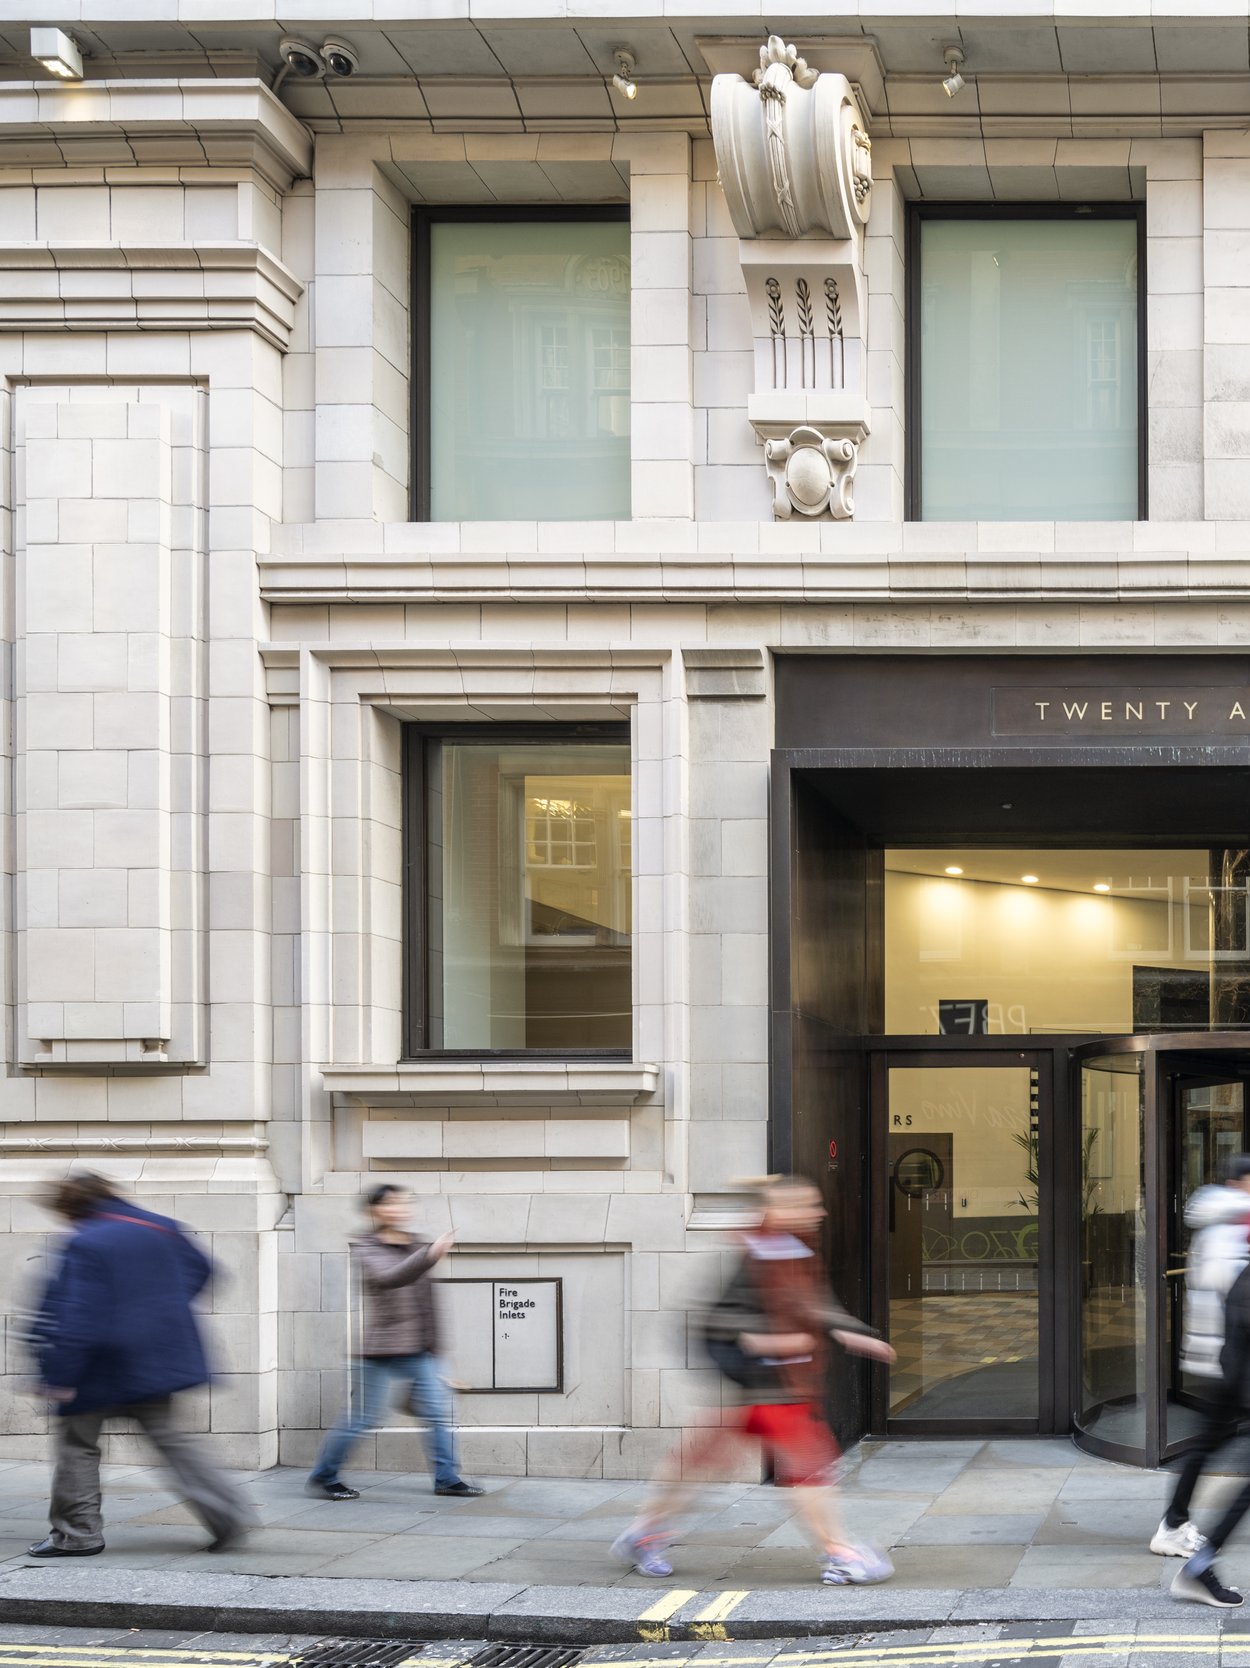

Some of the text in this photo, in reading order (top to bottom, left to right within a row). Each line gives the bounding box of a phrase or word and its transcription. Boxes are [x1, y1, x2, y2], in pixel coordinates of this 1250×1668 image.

[1035, 701, 1199, 721] TWENTY
[499, 1288, 518, 1297] Fire
[499, 1299, 536, 1310] Brigade
[499, 1311, 526, 1319] Inlets
